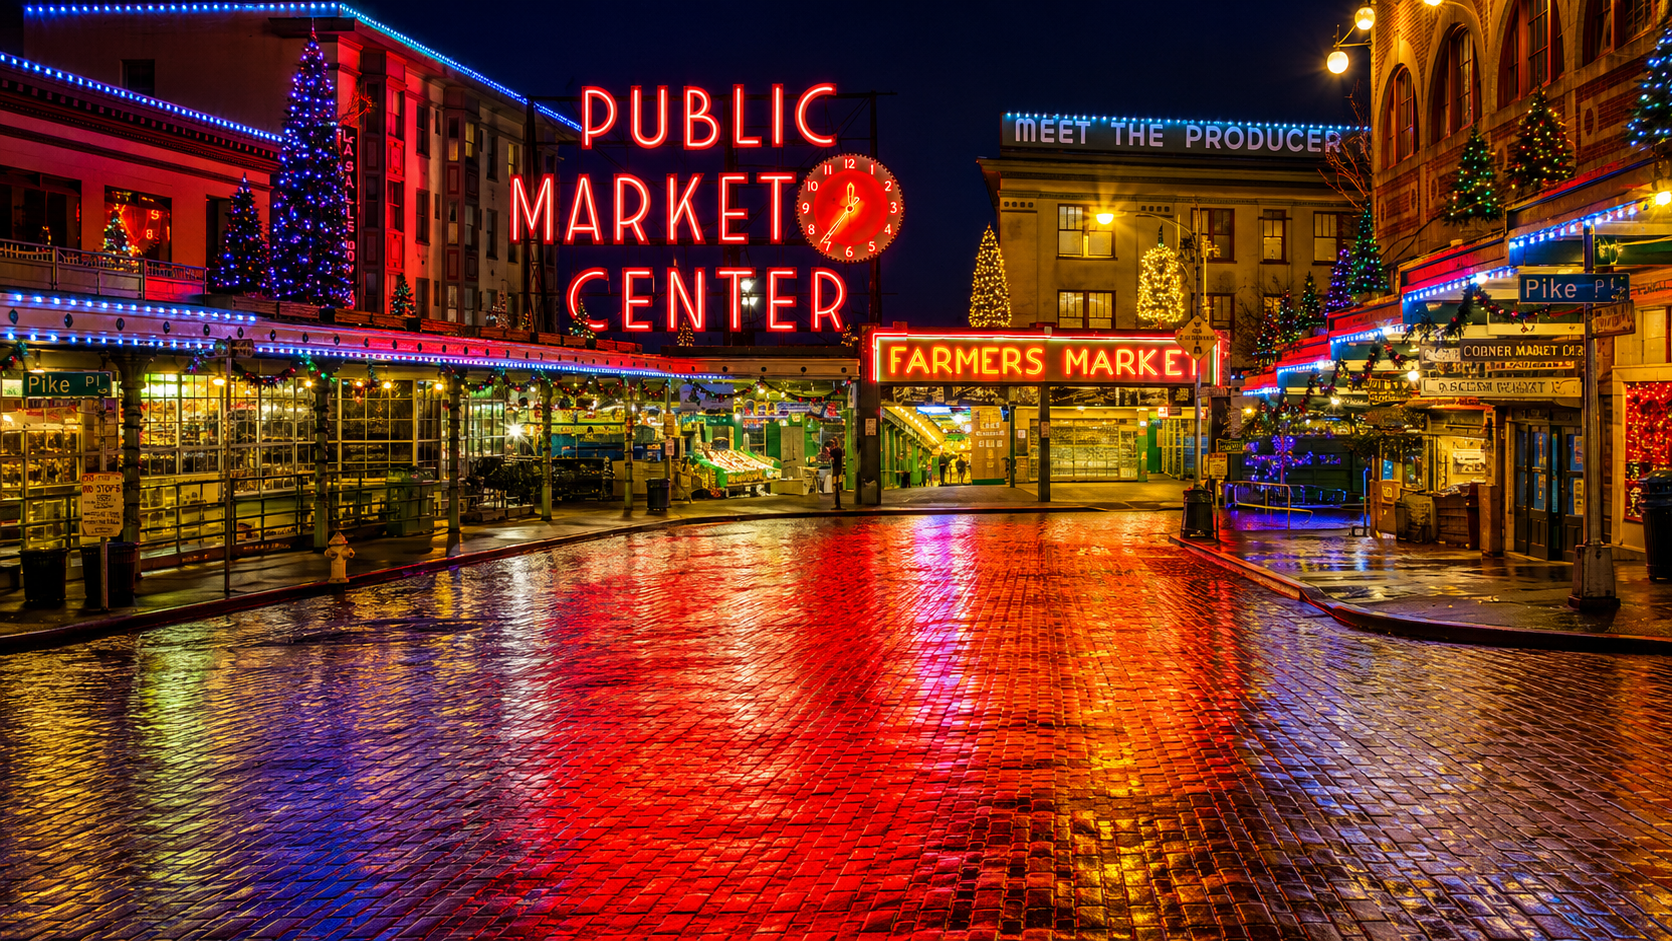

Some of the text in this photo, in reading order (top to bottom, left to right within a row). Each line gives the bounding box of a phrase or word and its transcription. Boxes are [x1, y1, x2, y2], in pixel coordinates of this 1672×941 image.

[581, 83, 837, 149] PUBLIC
[1015, 118, 1342, 153] MEET THE PRODUCER
[824, 164, 832, 175] 11
[845, 158, 856, 169] 12
[807, 180, 819, 192] 10
[884, 180, 892, 192] 2
[509, 172, 797, 245] MARKET
[802, 202, 810, 214] 9
[890, 201, 898, 213] 3
[807, 223, 815, 235] 8
[884, 223, 892, 235] 4
[823, 241, 832, 251] 7
[845, 246, 853, 257] 6
[868, 240, 876, 252] 5
[1526, 277, 1577, 299] Pike
[566, 267, 847, 333] CENTER
[890, 346, 1043, 375] FARMERS
[28, 375, 100, 394] Pike Pl
